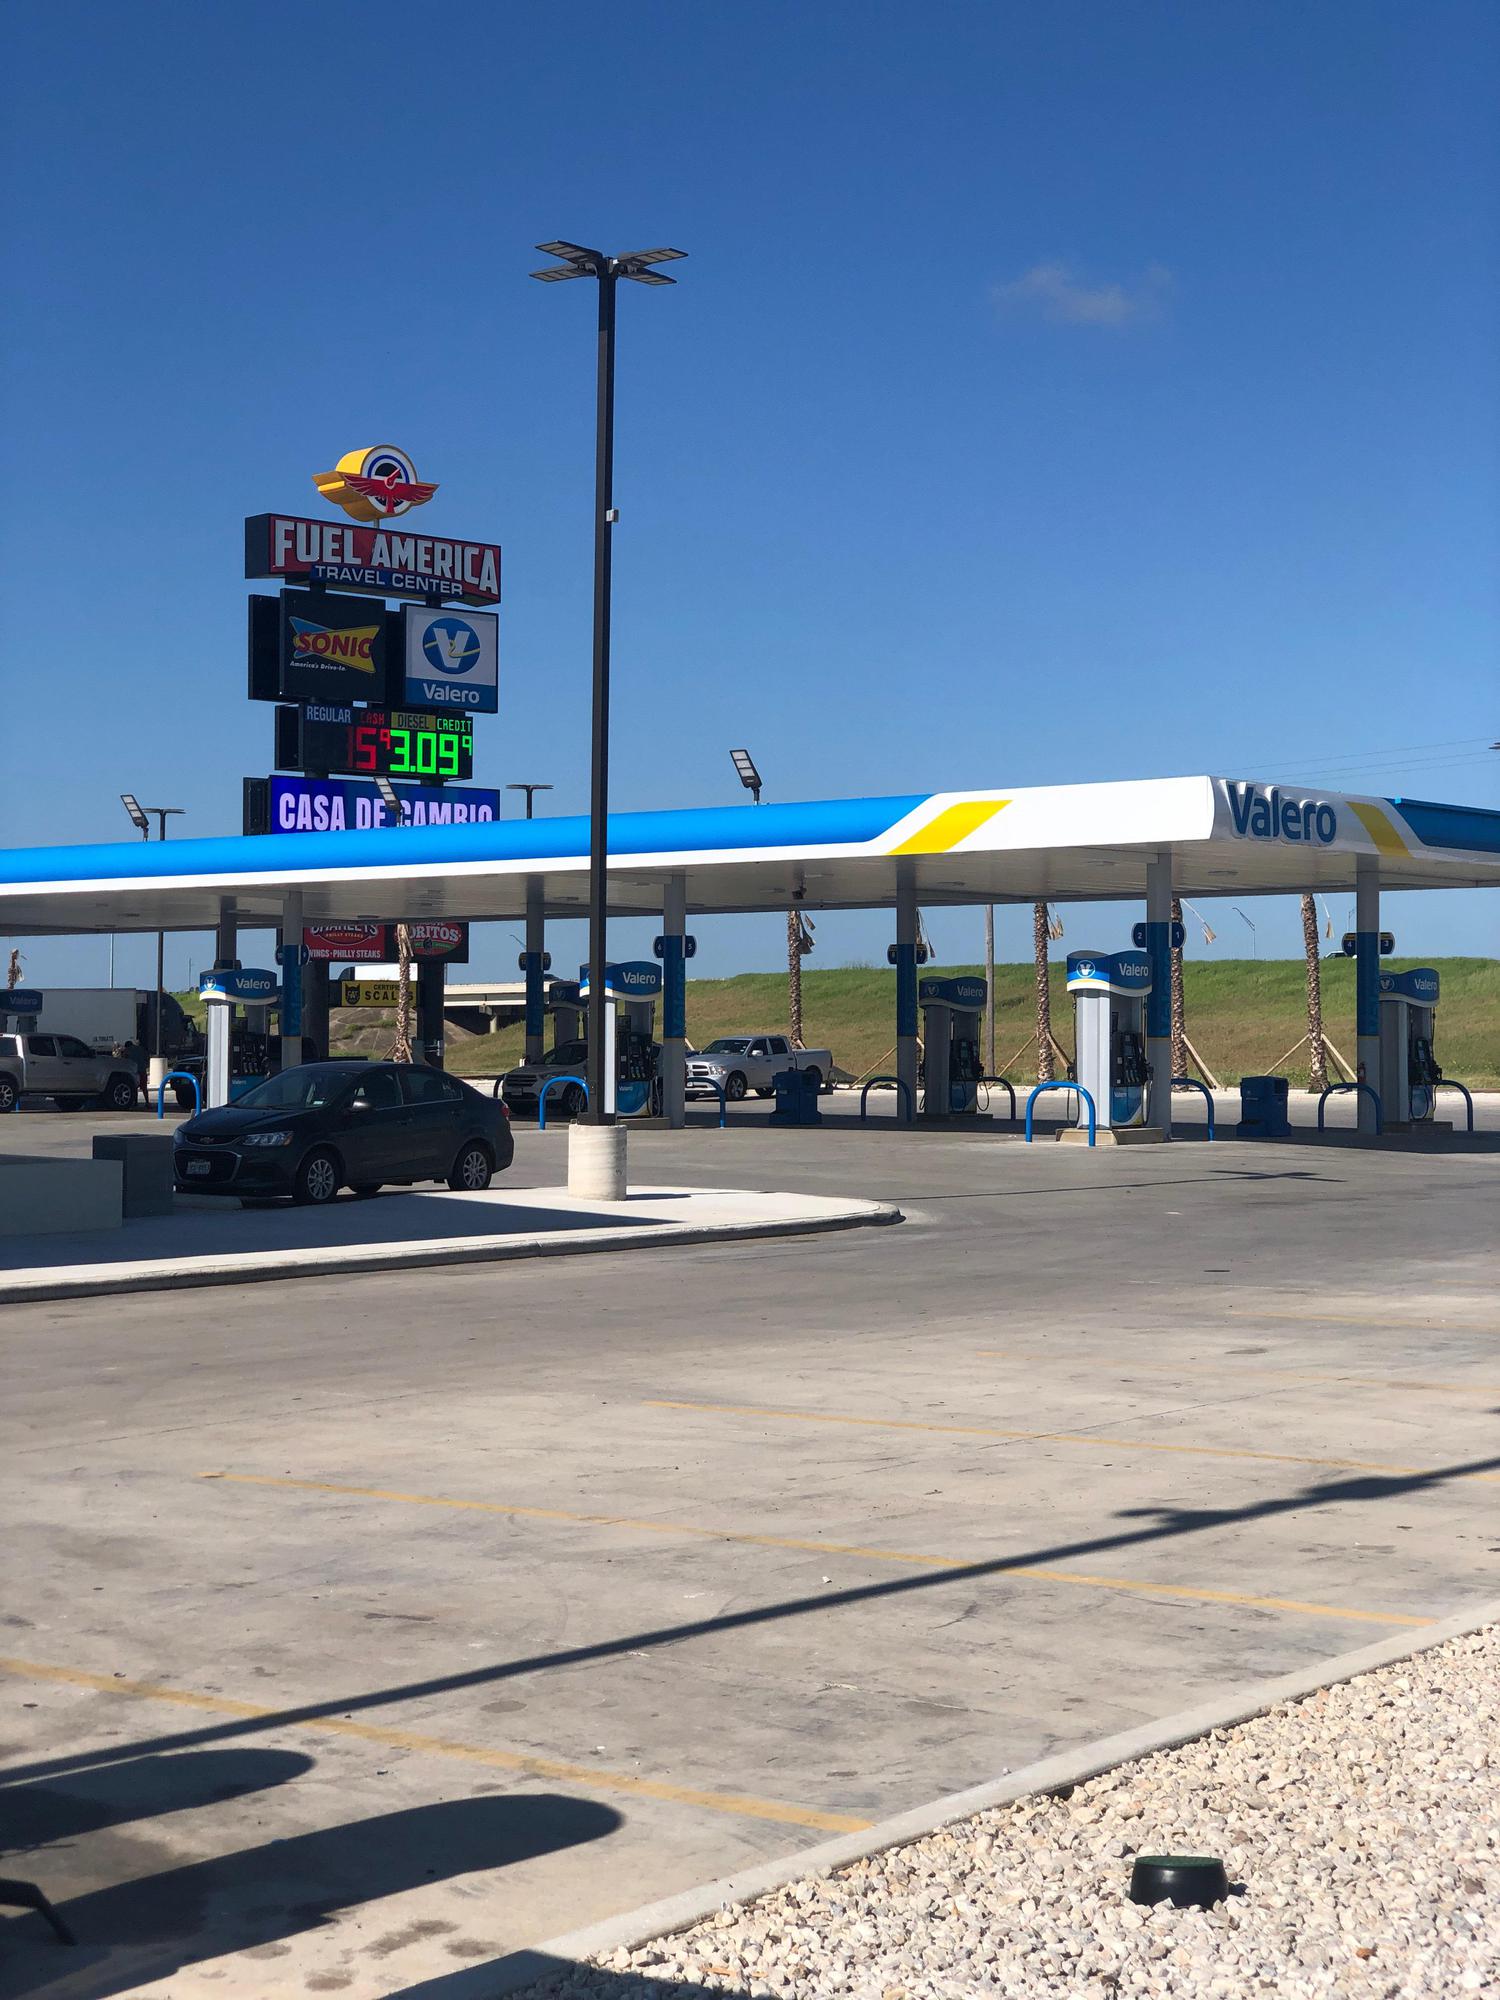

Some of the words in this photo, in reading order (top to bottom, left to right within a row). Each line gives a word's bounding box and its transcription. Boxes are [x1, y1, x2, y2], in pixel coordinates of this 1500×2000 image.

[274, 519, 362, 567] FUEL
[371, 533, 499, 595] AMERICA
[315, 565, 386, 585] TRAVEL
[391, 574, 463, 596] CENTER
[297, 631, 374, 659] SONIC
[289, 660, 319, 671] America's
[422, 682, 480, 704] Valero
[306, 705, 351, 724] REGULAR
[360, 710, 385, 725] CASH
[397, 713, 430, 730] DIESEL
[436, 718, 472, 733] CREDIT
[279, 792, 346, 831] CASA
[355, 797, 387, 830] DE
[1226, 782, 1338, 844] Valero
[1136, 931, 1143, 940] 2
[332, 949, 357, 959] PHILLY
[356, 949, 381, 959] STEAKS
[1118, 962, 1149, 977] Valero
[235, 977, 271, 990] Valero
[622, 970, 656, 985] Valero
[1413, 977, 1438, 991] Valero
[364, 990, 414, 1001] SCALS
[956, 984, 984, 998] Valero
[9, 996, 38, 1006] Valero
